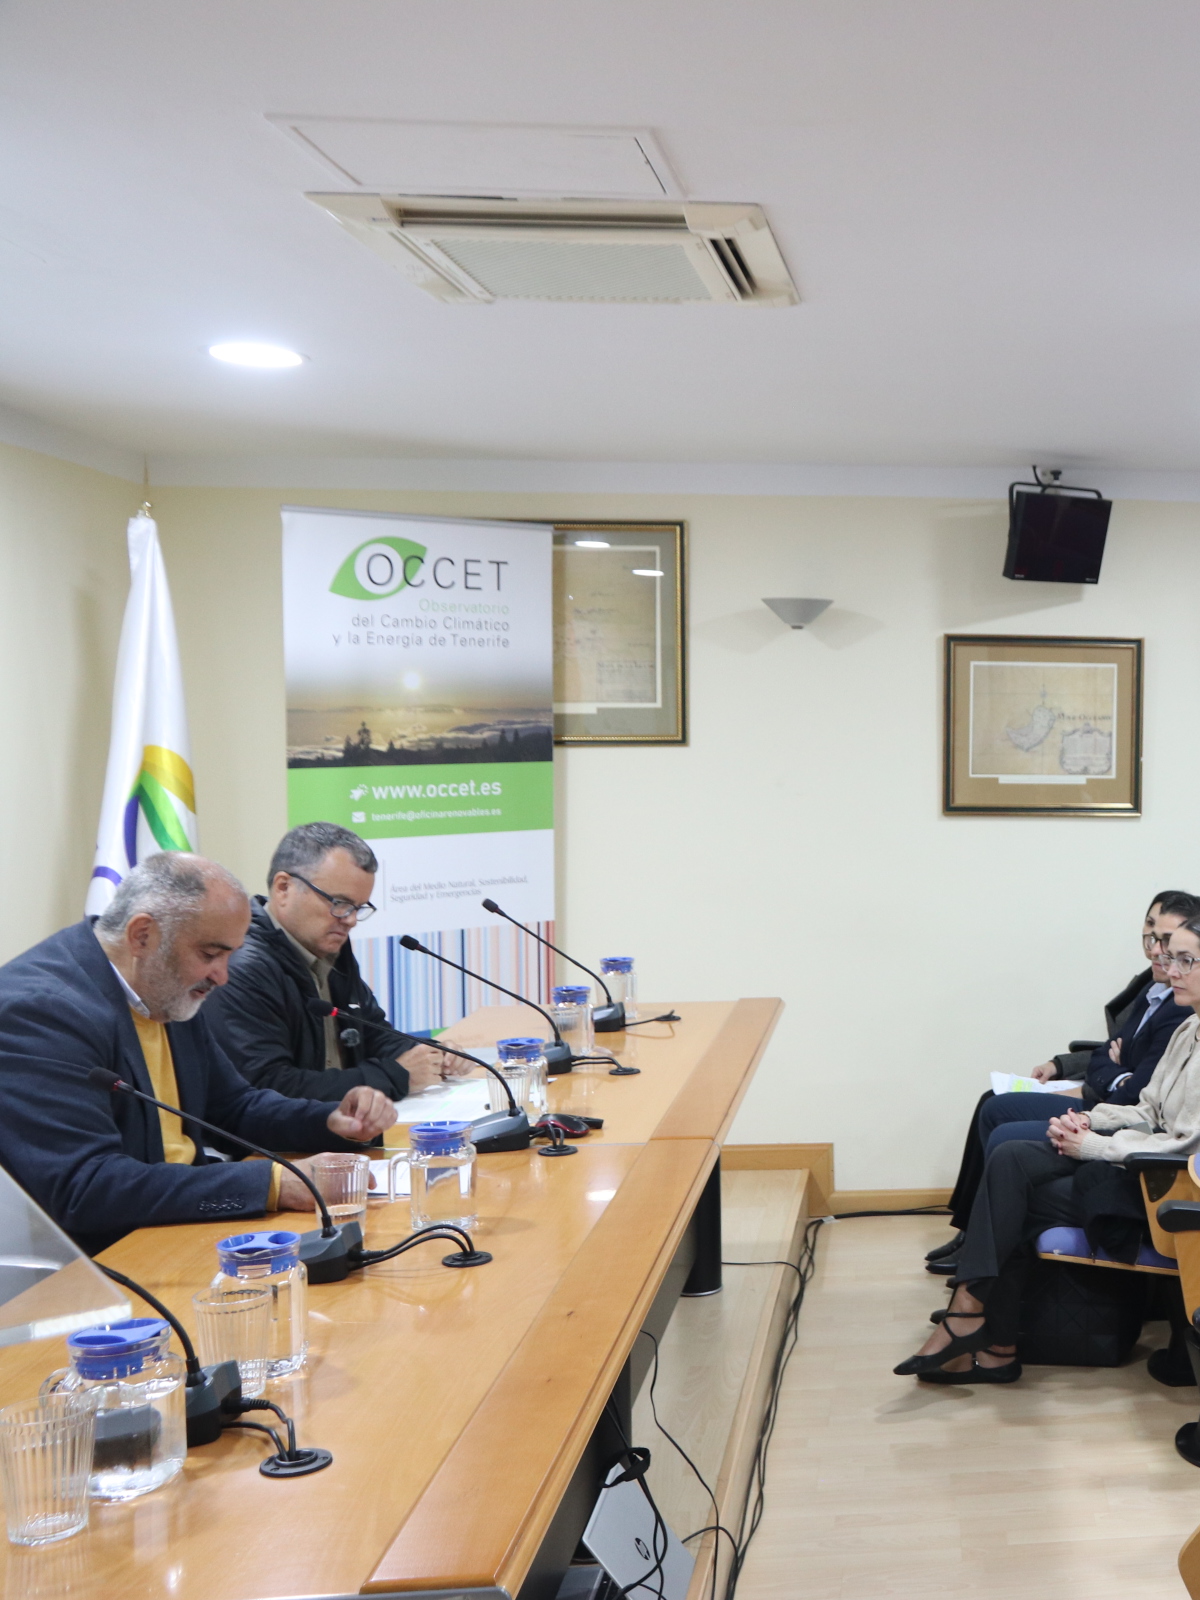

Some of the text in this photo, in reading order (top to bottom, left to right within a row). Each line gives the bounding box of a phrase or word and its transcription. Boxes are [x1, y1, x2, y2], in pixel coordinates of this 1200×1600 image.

[366, 553, 509, 591] OCCET
[419, 598, 510, 615] Observatorio
[351, 613, 510, 632] del Cambio Climático
[332, 631, 510, 648] y la Energía de Tenerife
[371, 779, 502, 799] www.occet.es
[371, 807, 502, 821] tenerife@oficinarenovables.es
